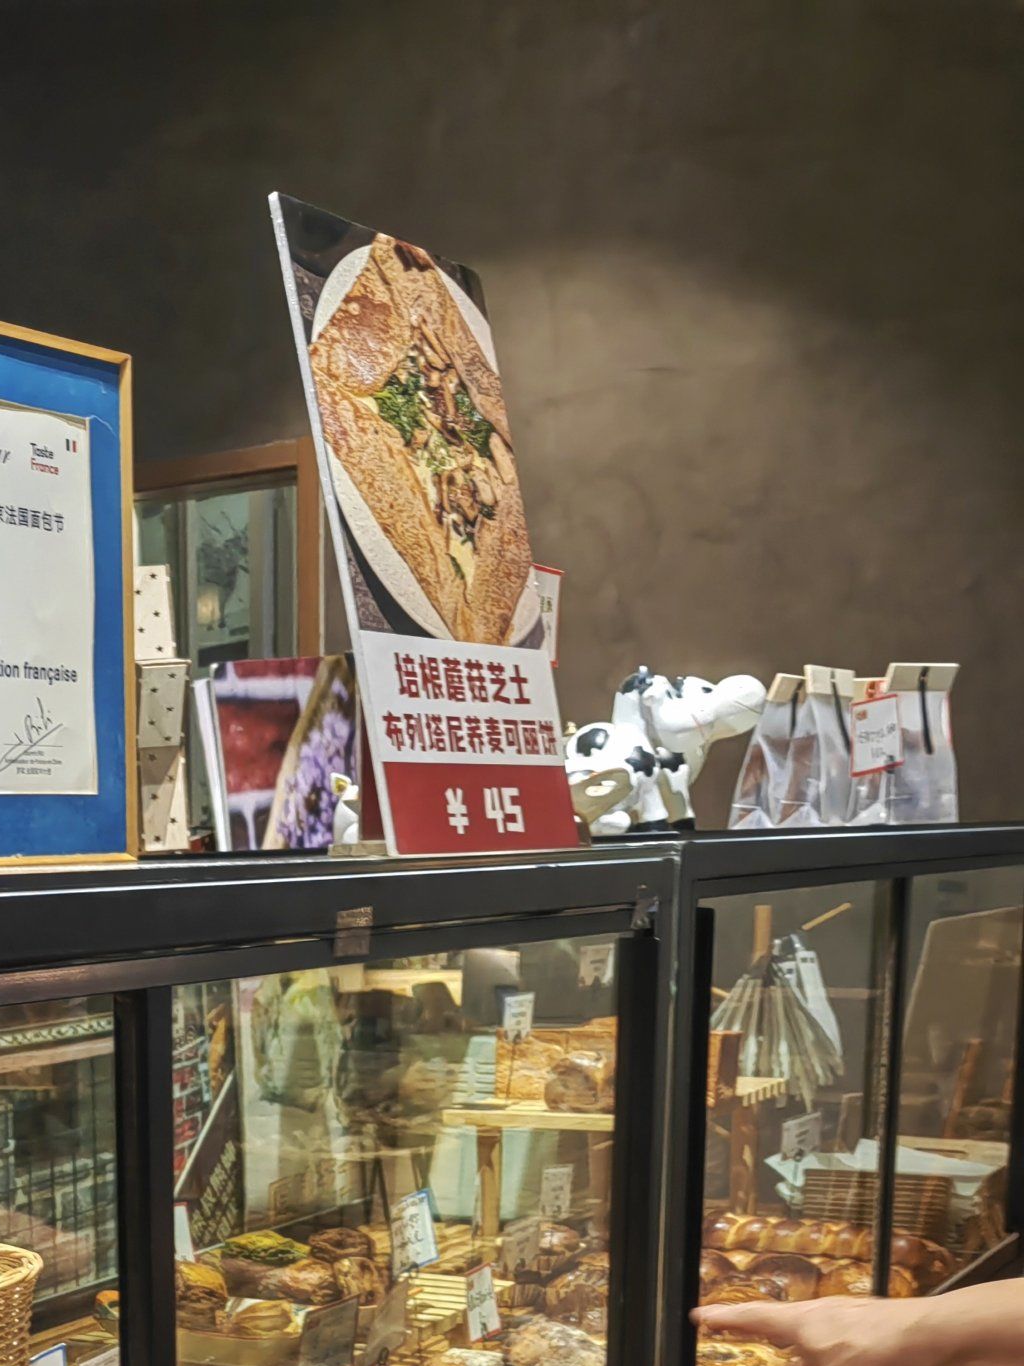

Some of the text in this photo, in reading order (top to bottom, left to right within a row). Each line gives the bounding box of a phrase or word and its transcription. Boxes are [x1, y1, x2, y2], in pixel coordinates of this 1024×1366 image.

[31, 458, 59, 475] France
[23, 661, 78, 685] française
[393, 651, 532, 705] 培根蘑菇芝士
[382, 710, 558, 756] 布列塔尼荞麦可丽饼
[483, 787, 526, 834] 45
